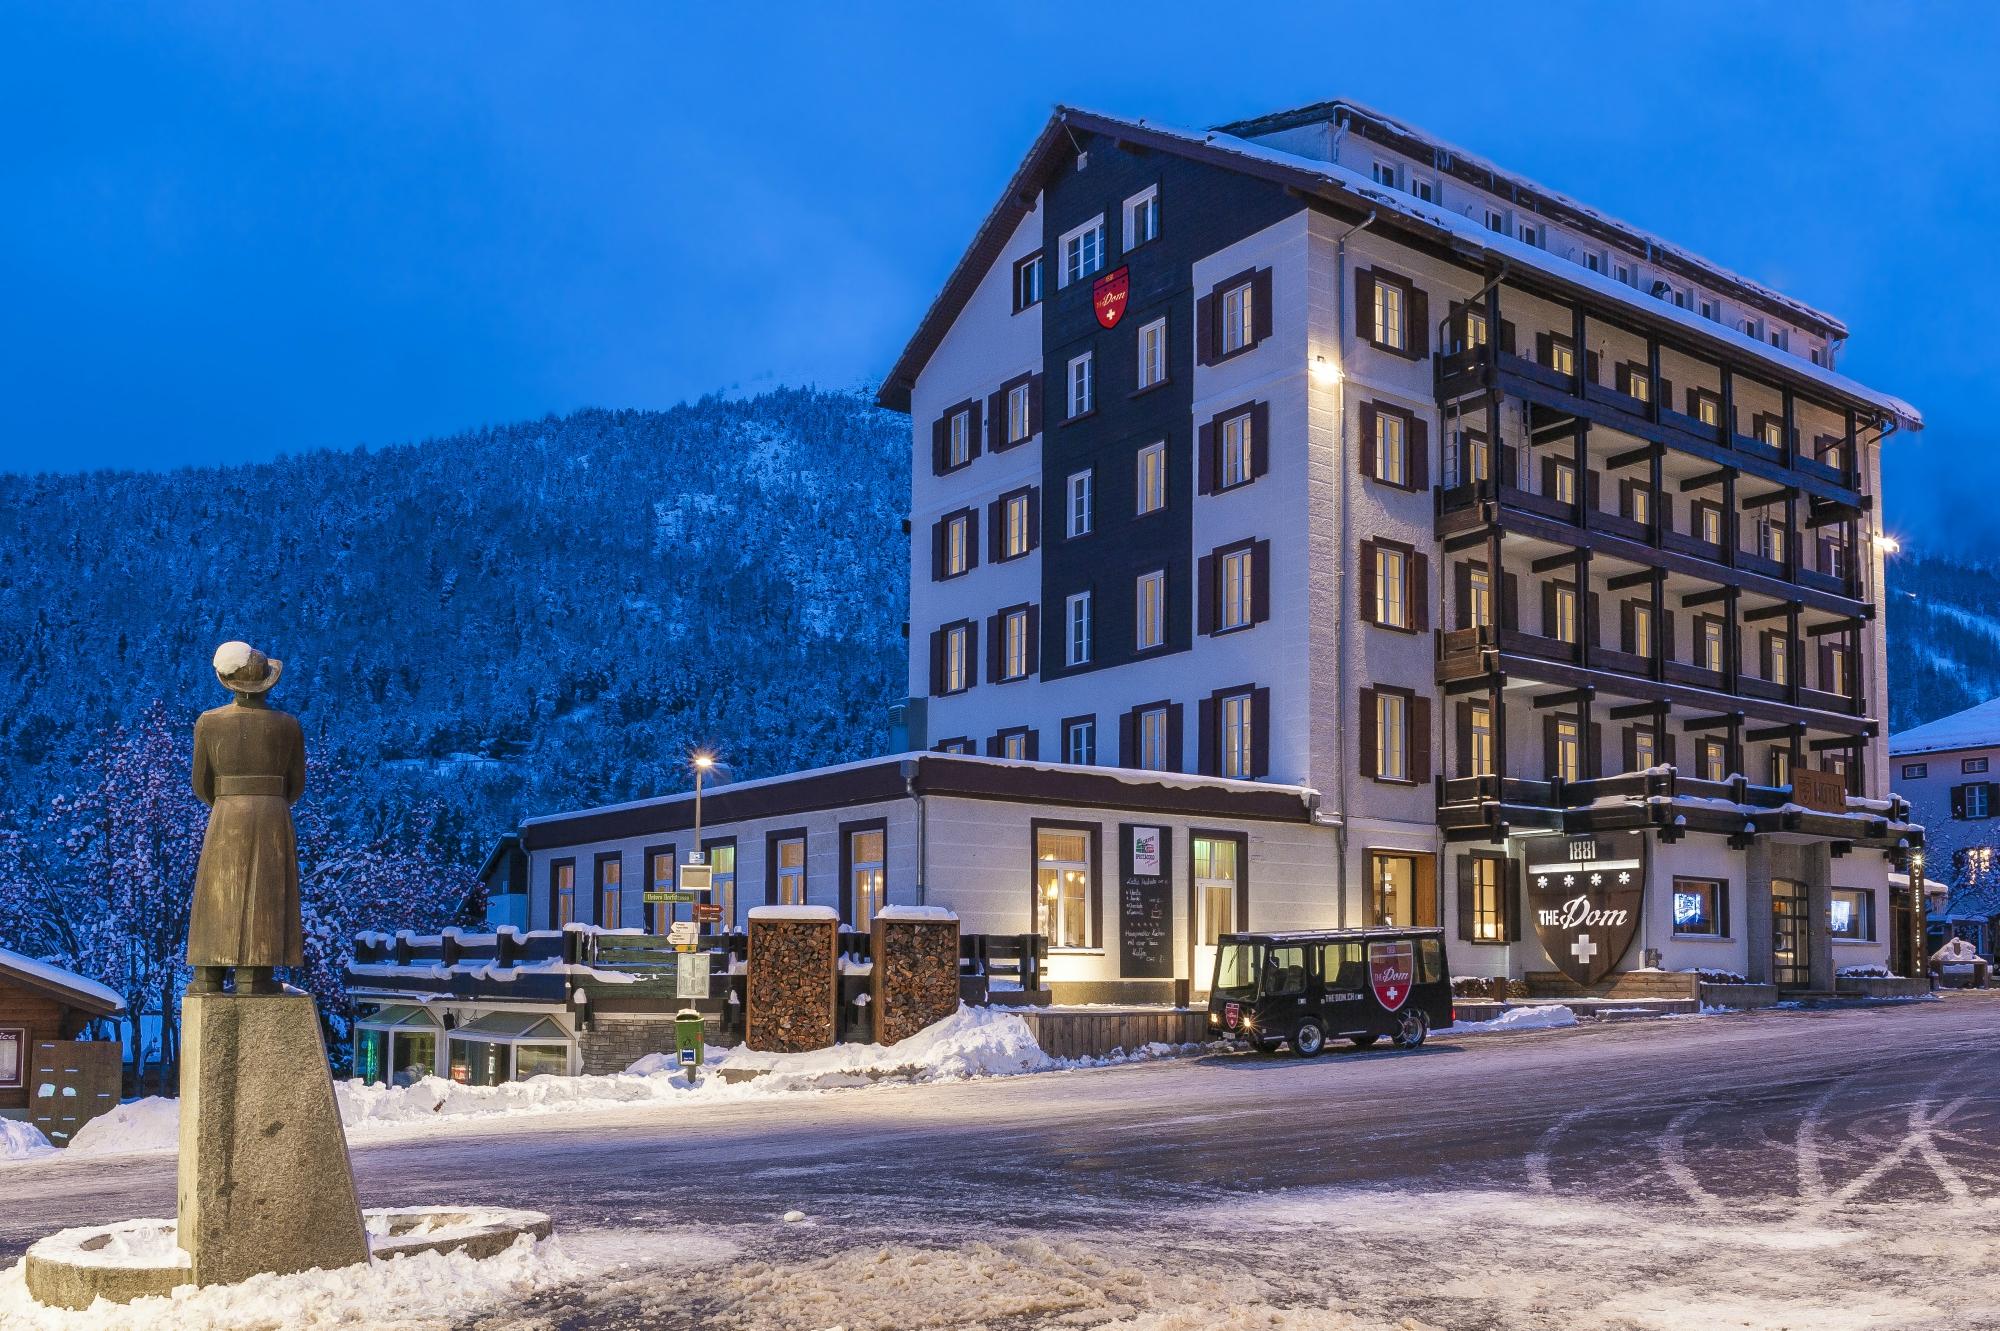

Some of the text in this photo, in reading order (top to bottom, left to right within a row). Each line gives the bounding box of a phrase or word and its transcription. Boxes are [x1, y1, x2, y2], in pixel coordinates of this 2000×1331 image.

[1103, 291, 1126, 307] Dom
[1569, 840, 1596, 861] 1881
[1538, 894, 1628, 930] THE Dom
[1383, 967, 1408, 982] Dom
